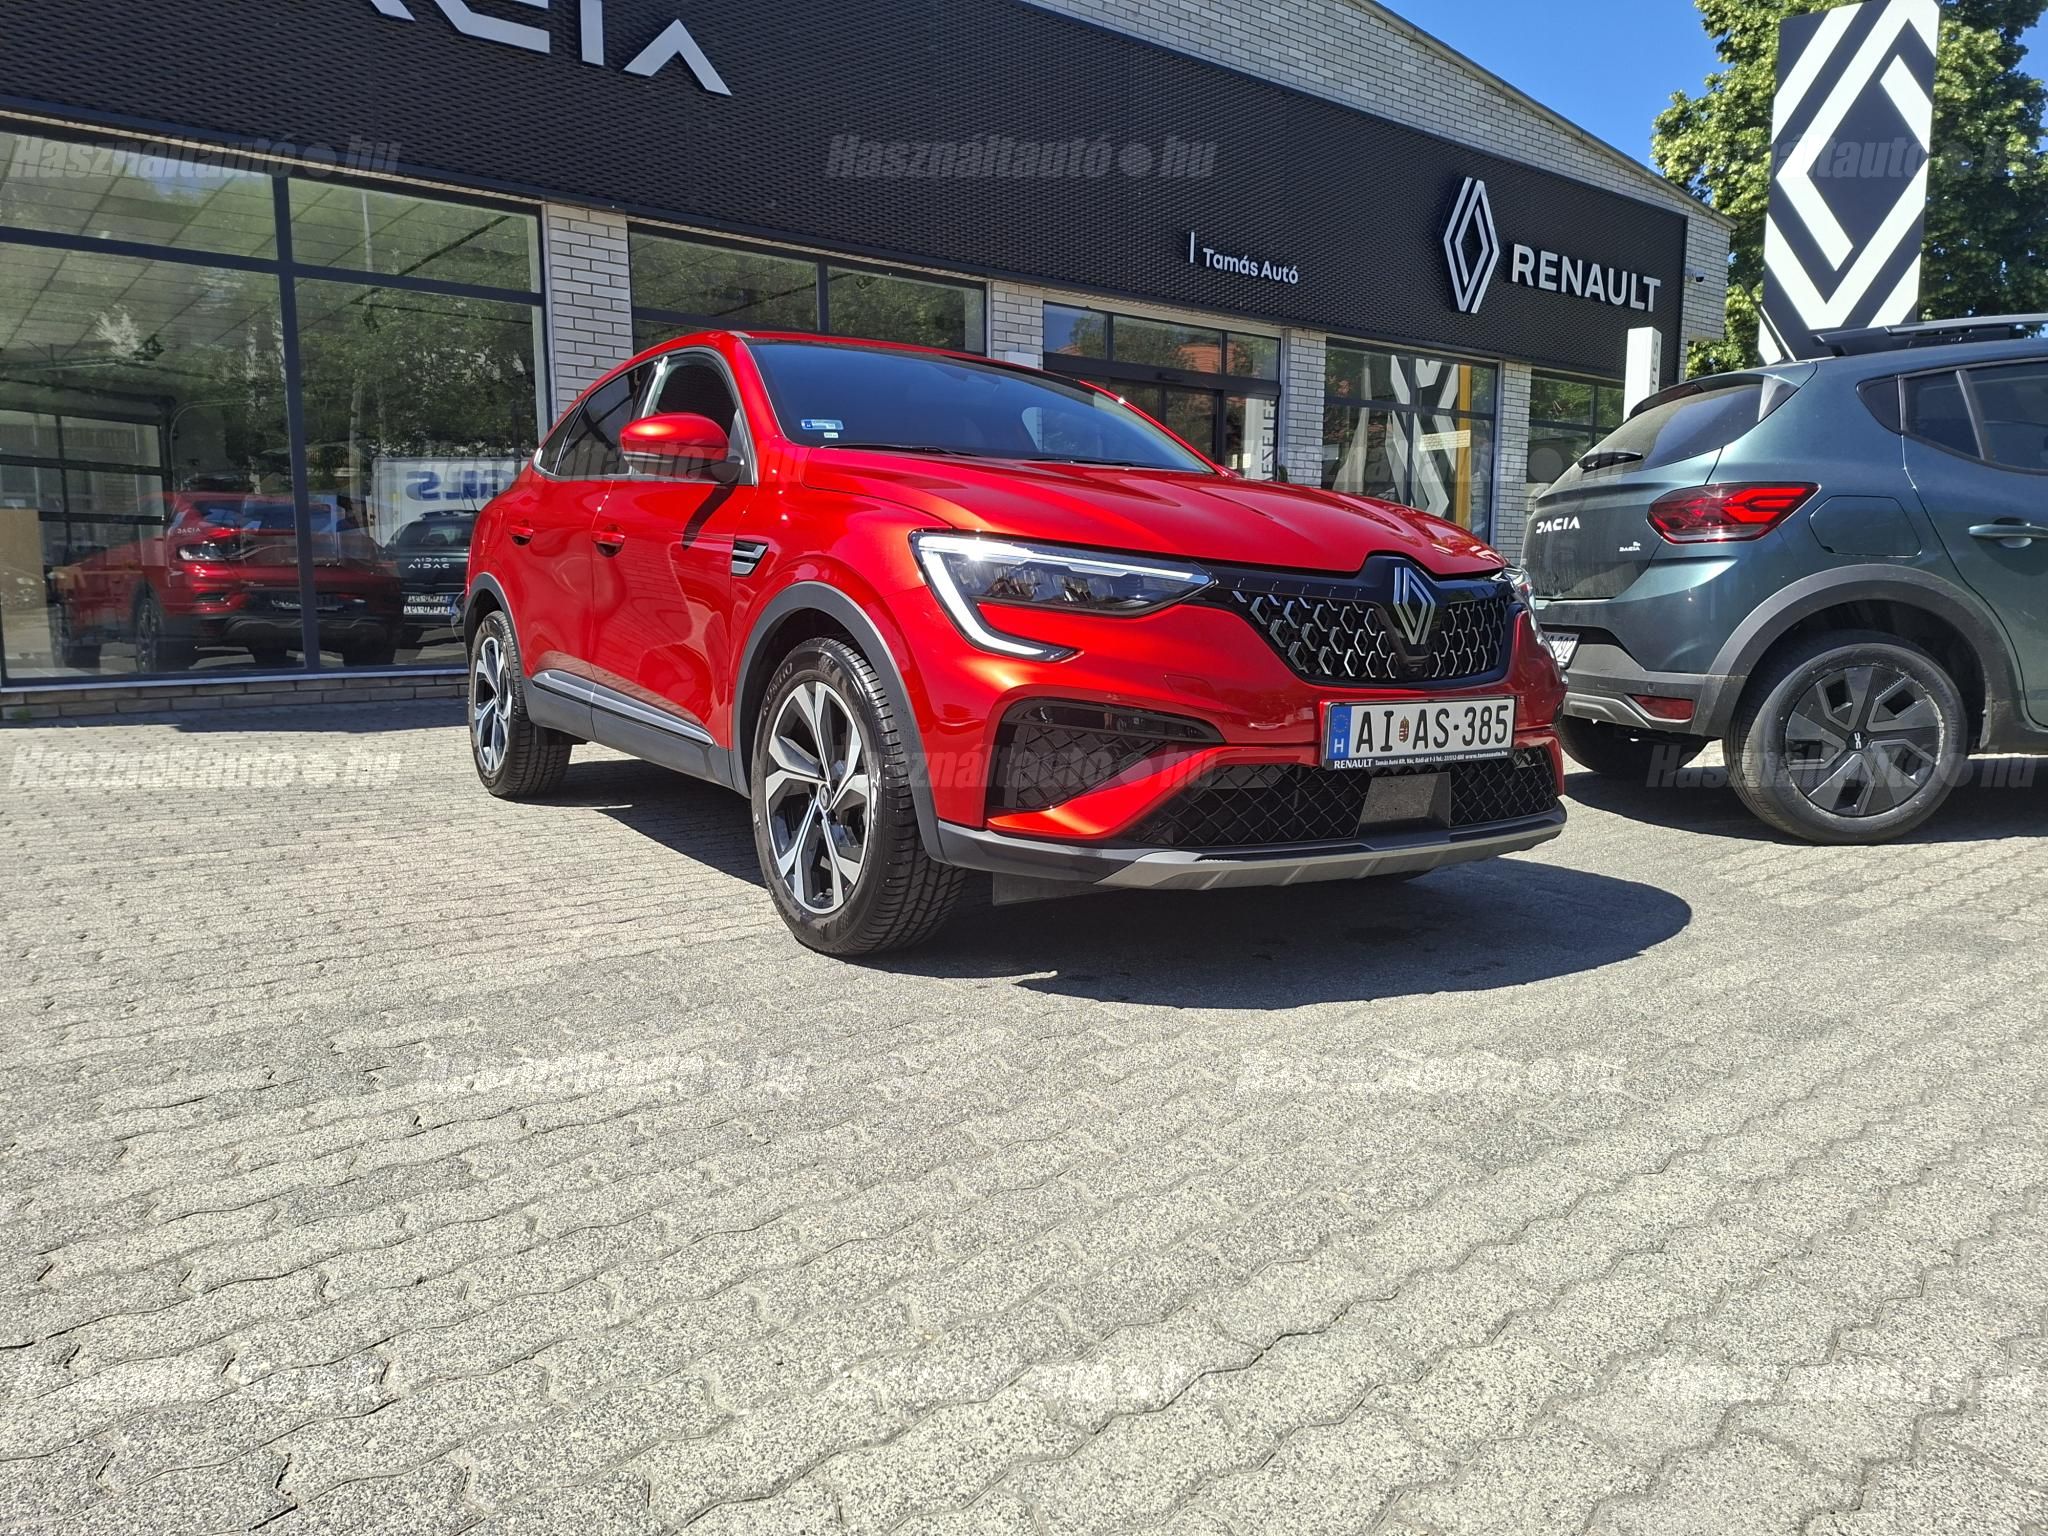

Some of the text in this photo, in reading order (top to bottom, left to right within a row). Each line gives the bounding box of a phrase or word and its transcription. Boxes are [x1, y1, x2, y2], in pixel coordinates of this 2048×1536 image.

[367, 0, 733, 97] CIA
[1202, 247, 1299, 285] Tamás Autó
[1511, 243, 1662, 312] RENAULT
[1535, 515, 1581, 534] DACIA
[1333, 738, 1344, 754] H
[1355, 710, 1395, 753] AI
[1334, 759, 1373, 769] RENAULT
